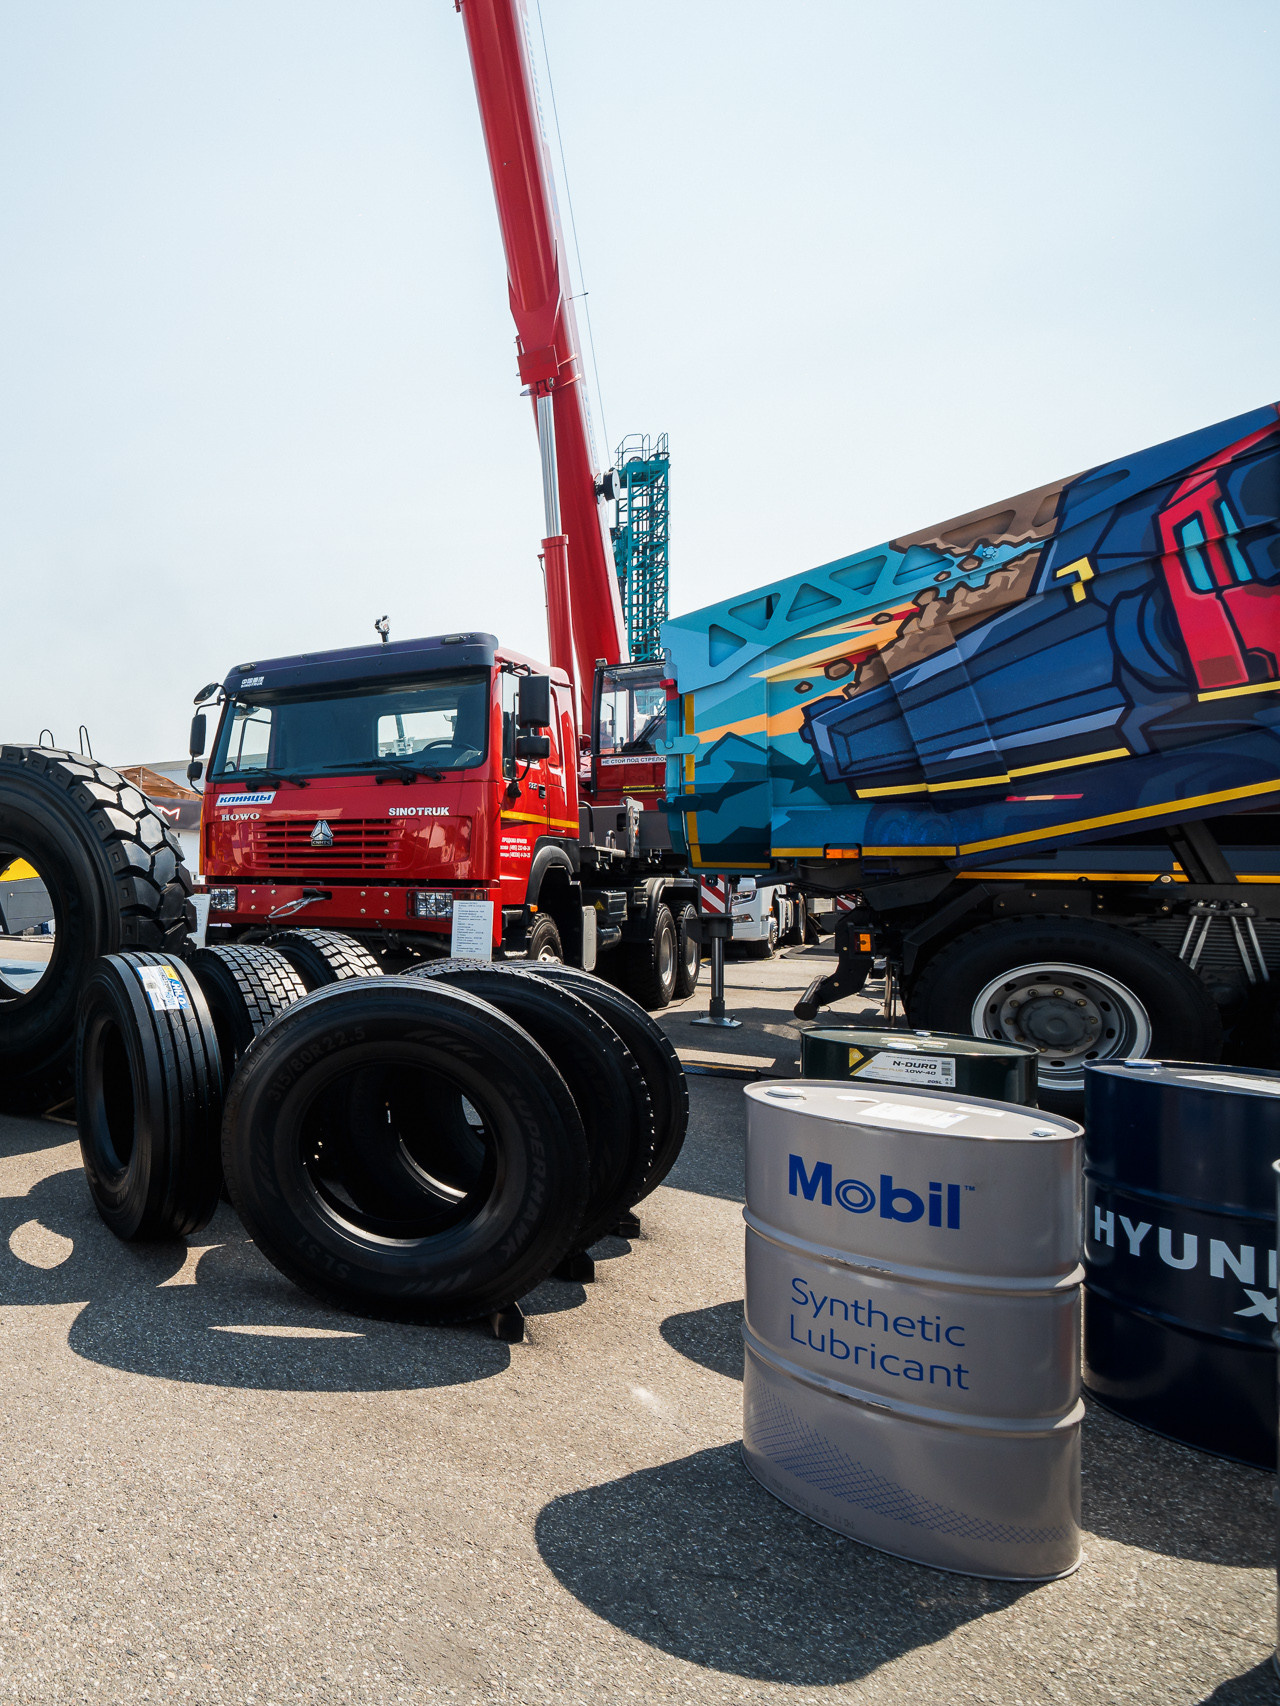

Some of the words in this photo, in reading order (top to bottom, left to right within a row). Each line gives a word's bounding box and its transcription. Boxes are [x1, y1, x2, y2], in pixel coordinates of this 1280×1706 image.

[219, 794, 273, 805] КЛИНЦЫ
[221, 812, 260, 822] HOWO
[388, 806, 450, 817] SINOTRUK
[892, 1060, 938, 1070] N-DURO
[905, 1068, 937, 1076] 10W-40
[791, 1277, 967, 1347] Synthetic
[790, 1313, 970, 1390] Lubricant
